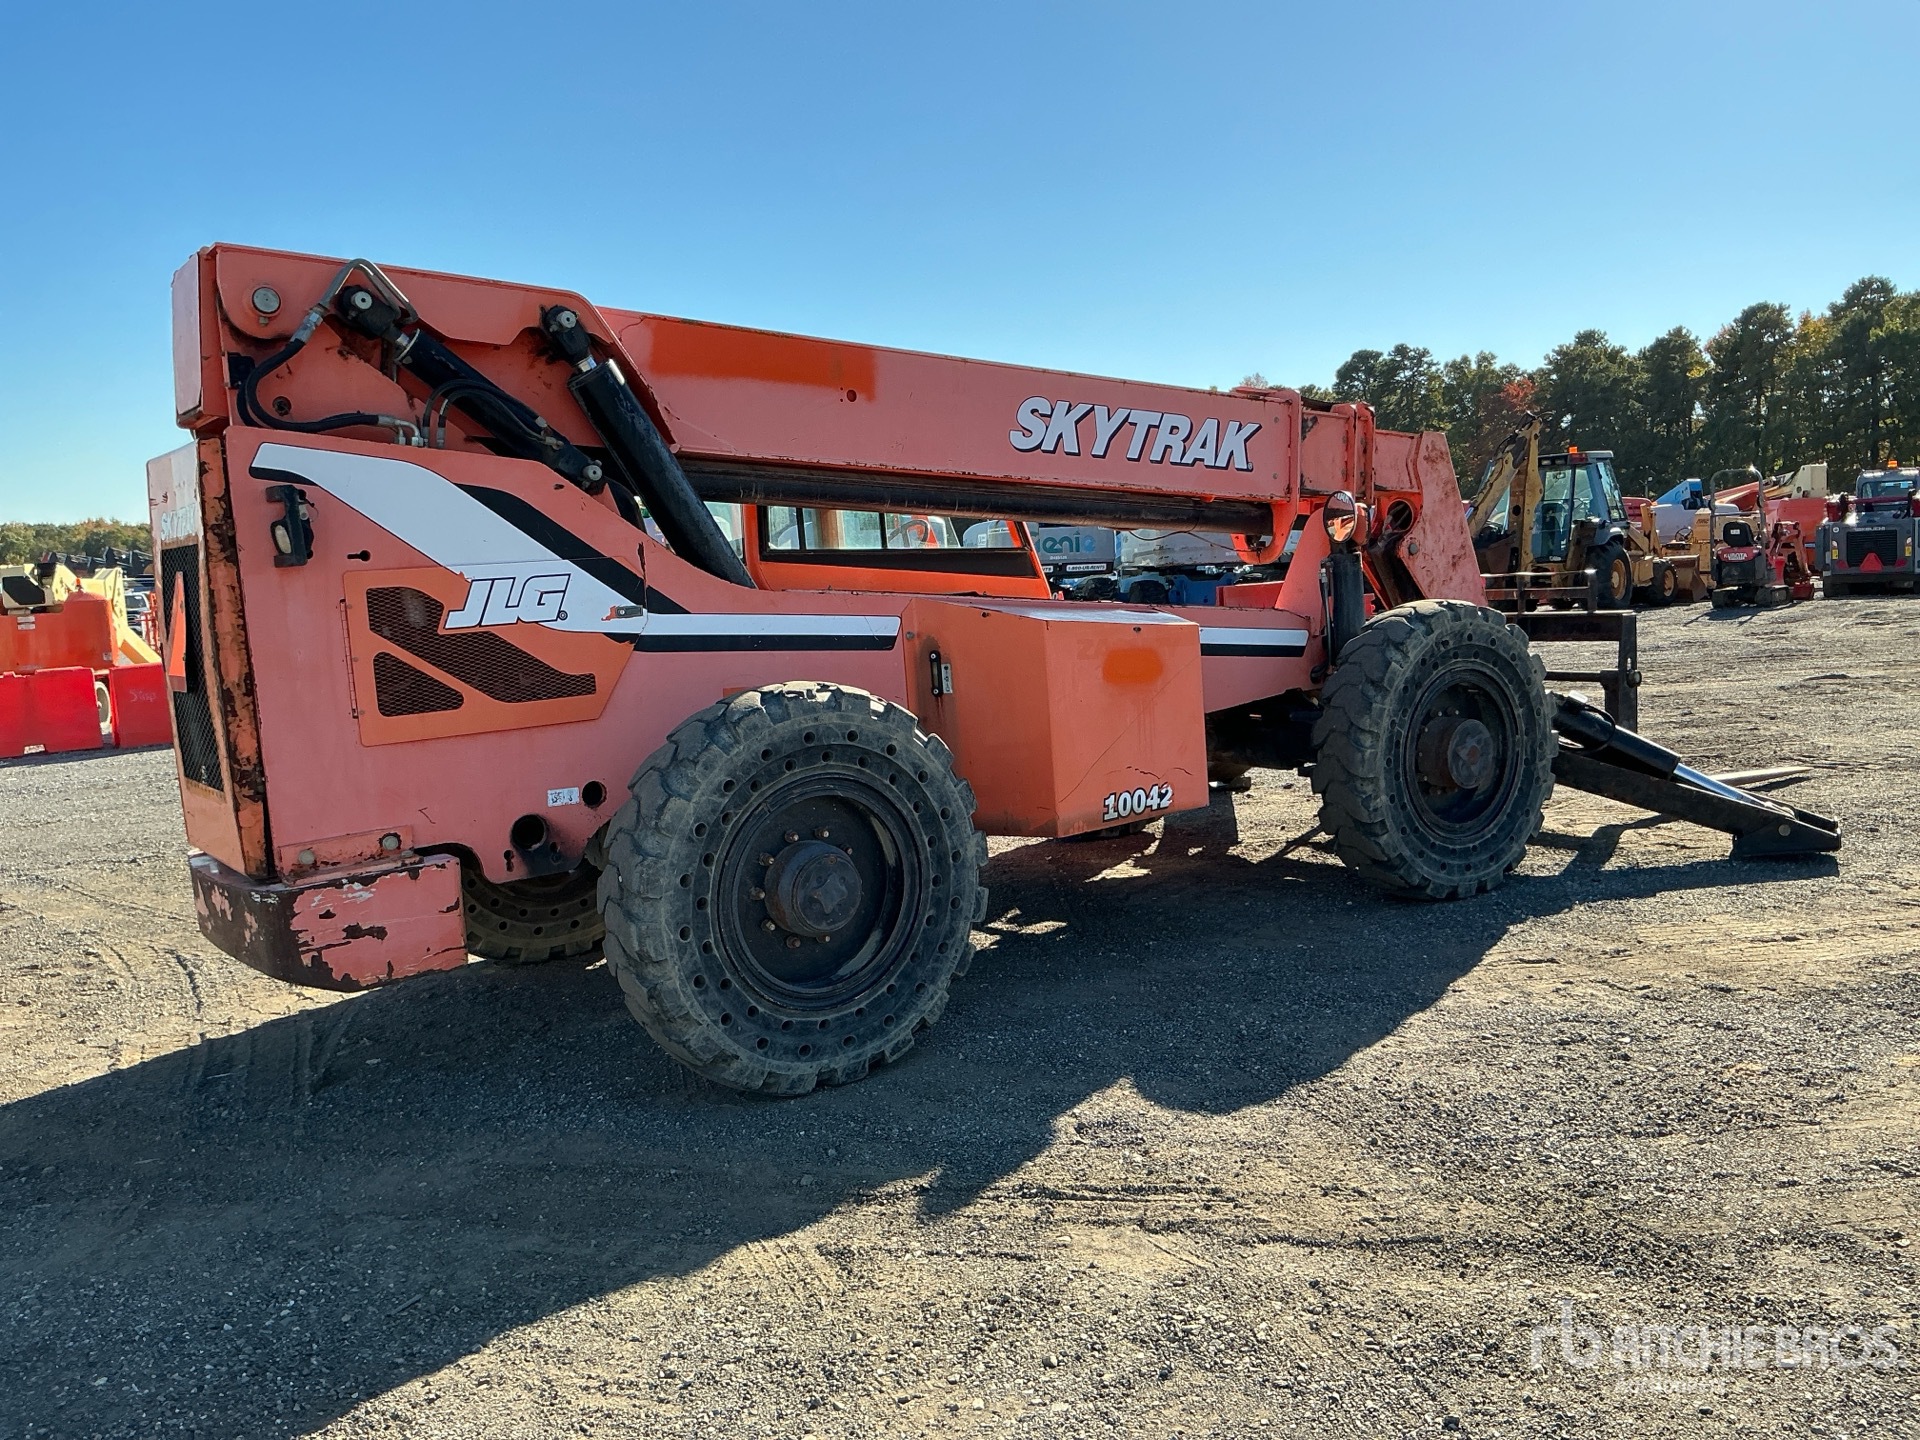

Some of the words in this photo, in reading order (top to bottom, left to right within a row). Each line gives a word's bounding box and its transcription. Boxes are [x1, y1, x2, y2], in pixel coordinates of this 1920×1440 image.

[1009, 396, 1262, 472] SKYTRAK
[443, 573, 571, 629] JLG
[1103, 782, 1174, 822] 10042
